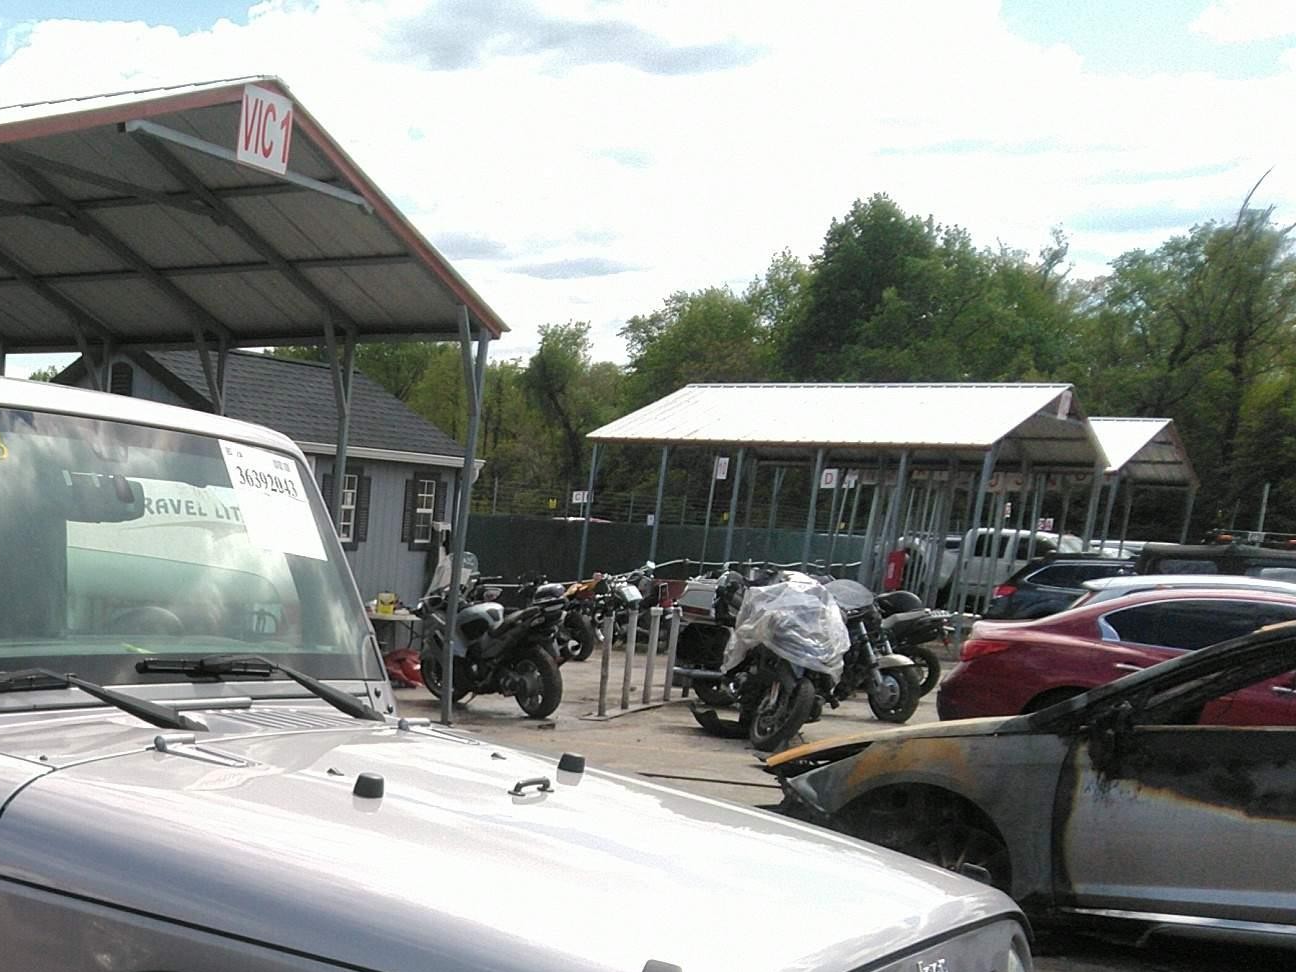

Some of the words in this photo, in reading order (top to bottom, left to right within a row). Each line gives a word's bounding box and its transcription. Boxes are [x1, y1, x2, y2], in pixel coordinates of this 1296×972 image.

[244, 94, 276, 159] VIC
[280, 110, 291, 164] 1
[236, 466, 299, 497] 36392043
[144, 497, 208, 517] RAVEL
[215, 505, 241, 522] LIT
